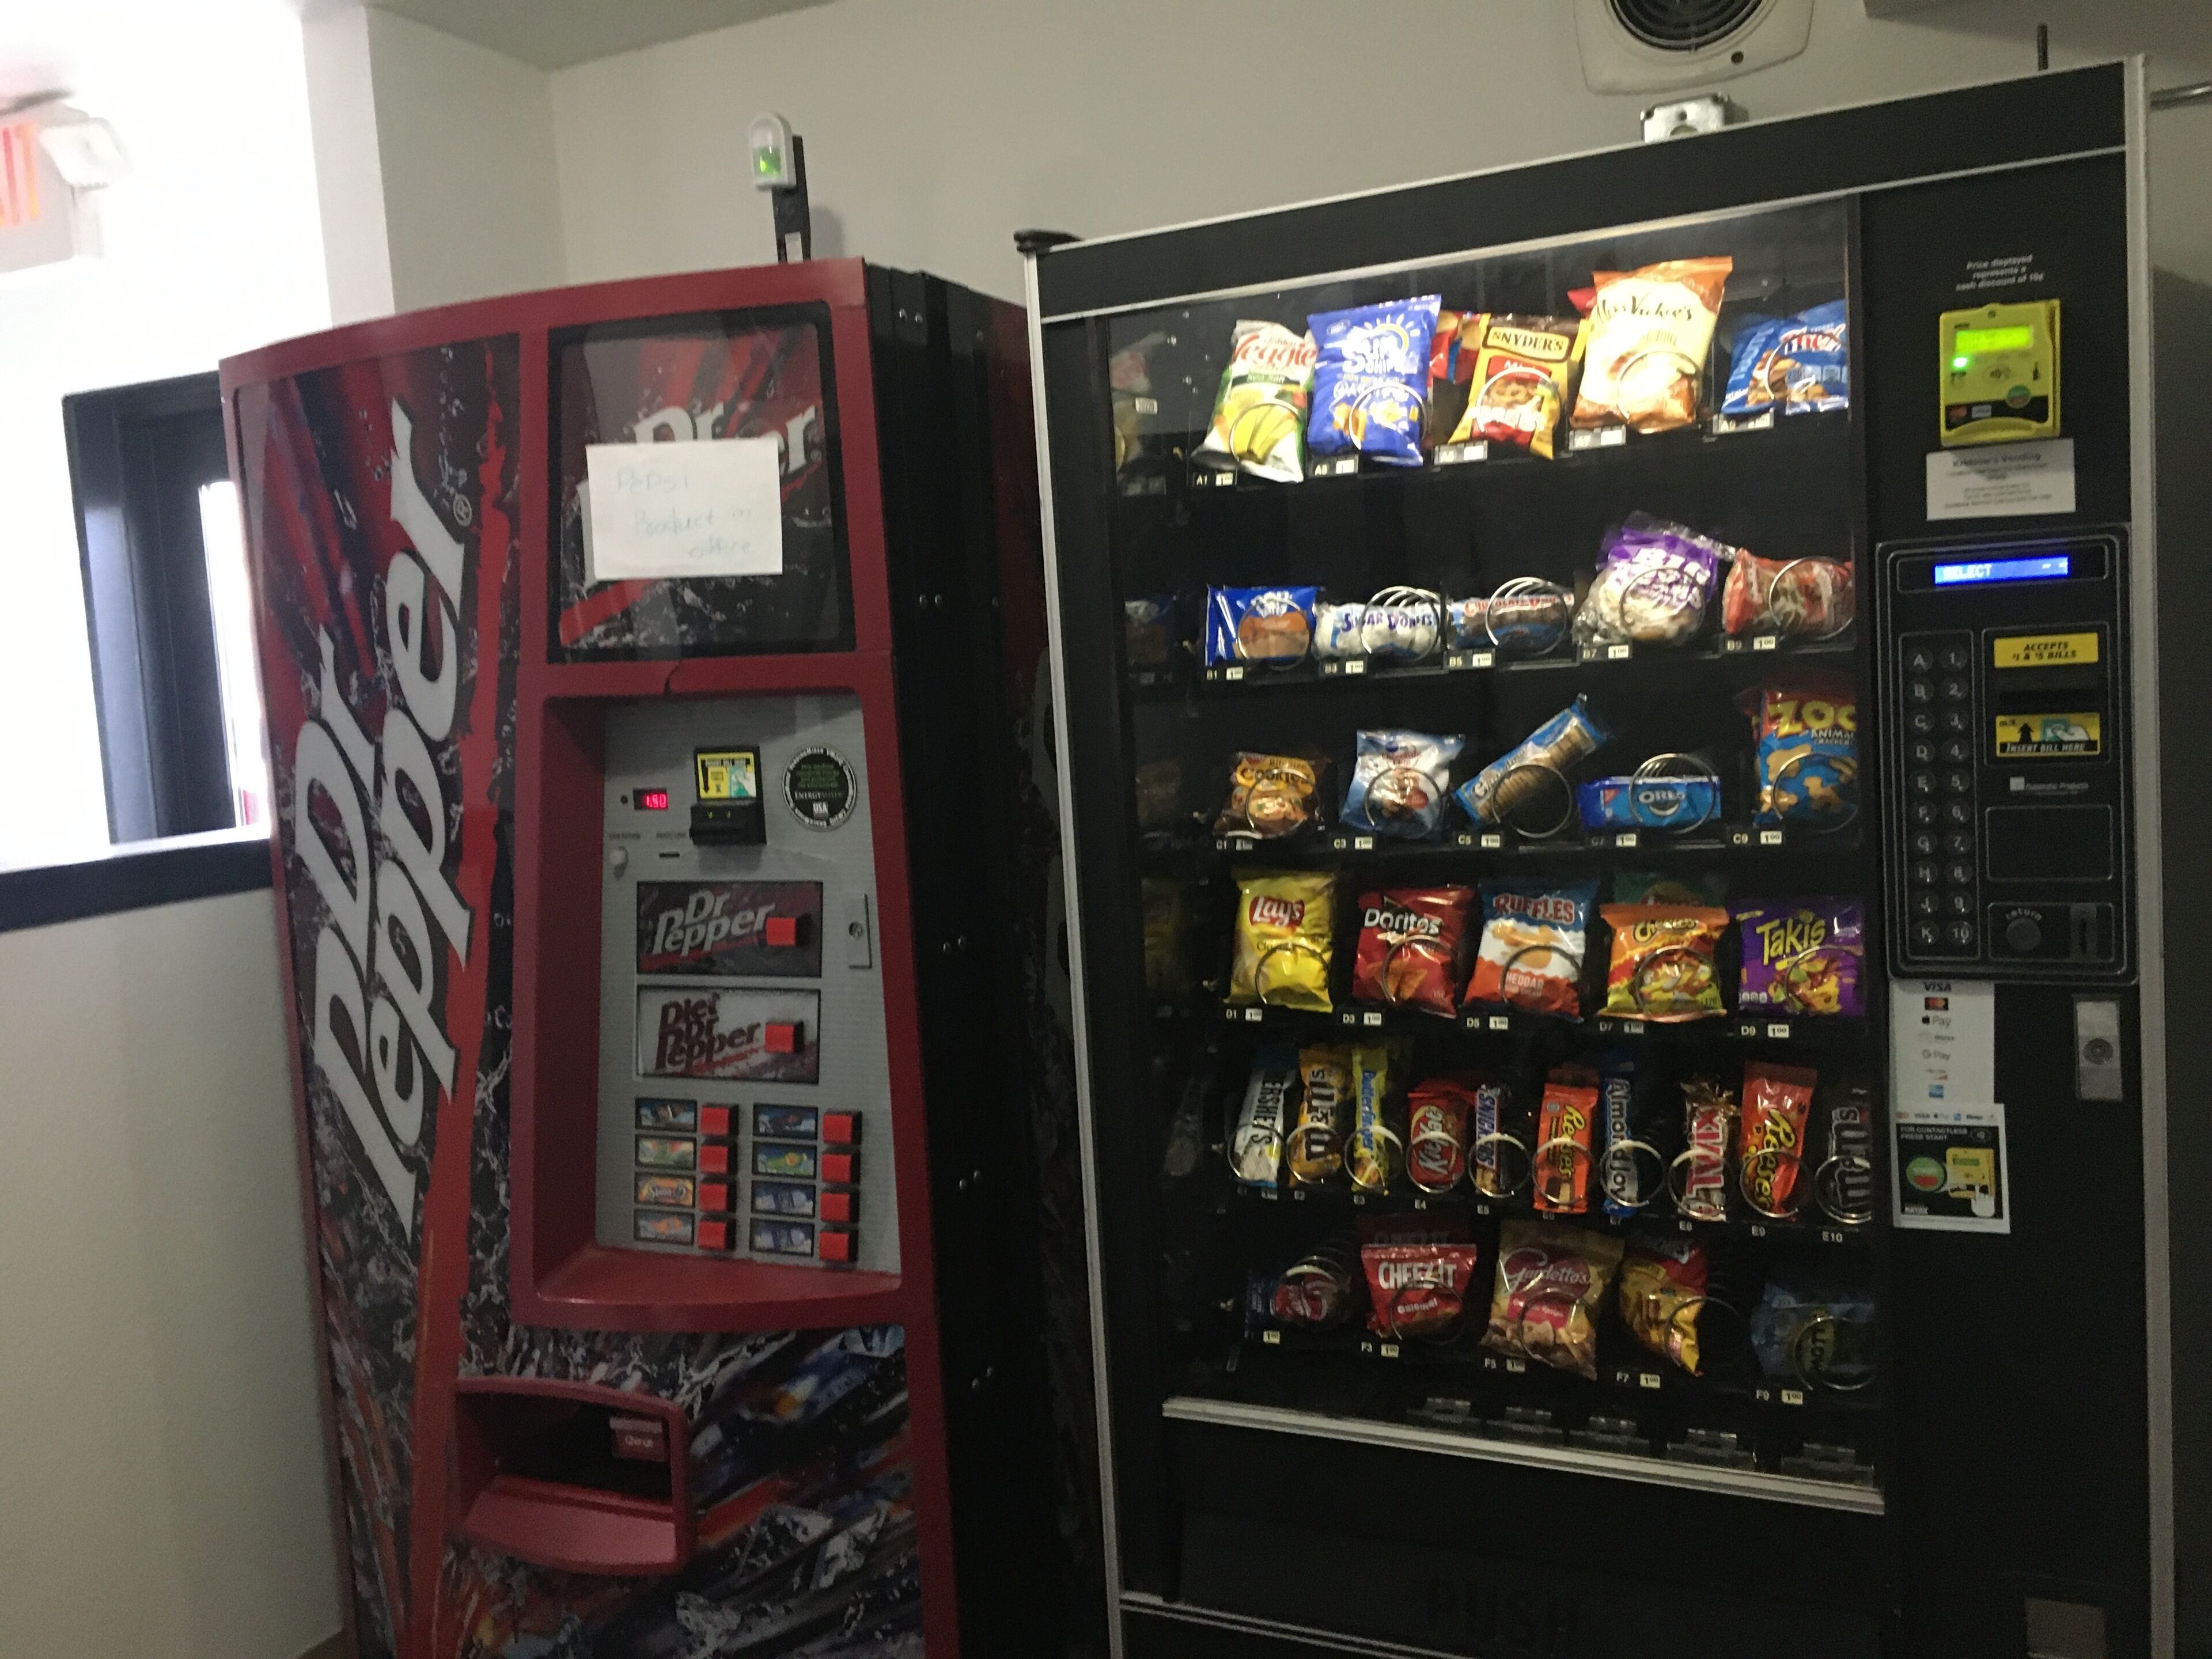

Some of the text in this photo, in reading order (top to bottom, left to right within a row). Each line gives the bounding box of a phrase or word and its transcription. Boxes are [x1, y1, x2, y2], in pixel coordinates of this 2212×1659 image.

[688, 888, 732, 925] Dr
[1493, 894, 1575, 925] RUFFLES
[652, 902, 776, 957] Pepper
[1364, 908, 1442, 934] Doritos
[1756, 917, 1826, 966] Takis
[1502, 972, 1544, 988] HEDDAR
[1924, 980, 1952, 992] VISA
[1822, 1232, 1843, 1243] E10
